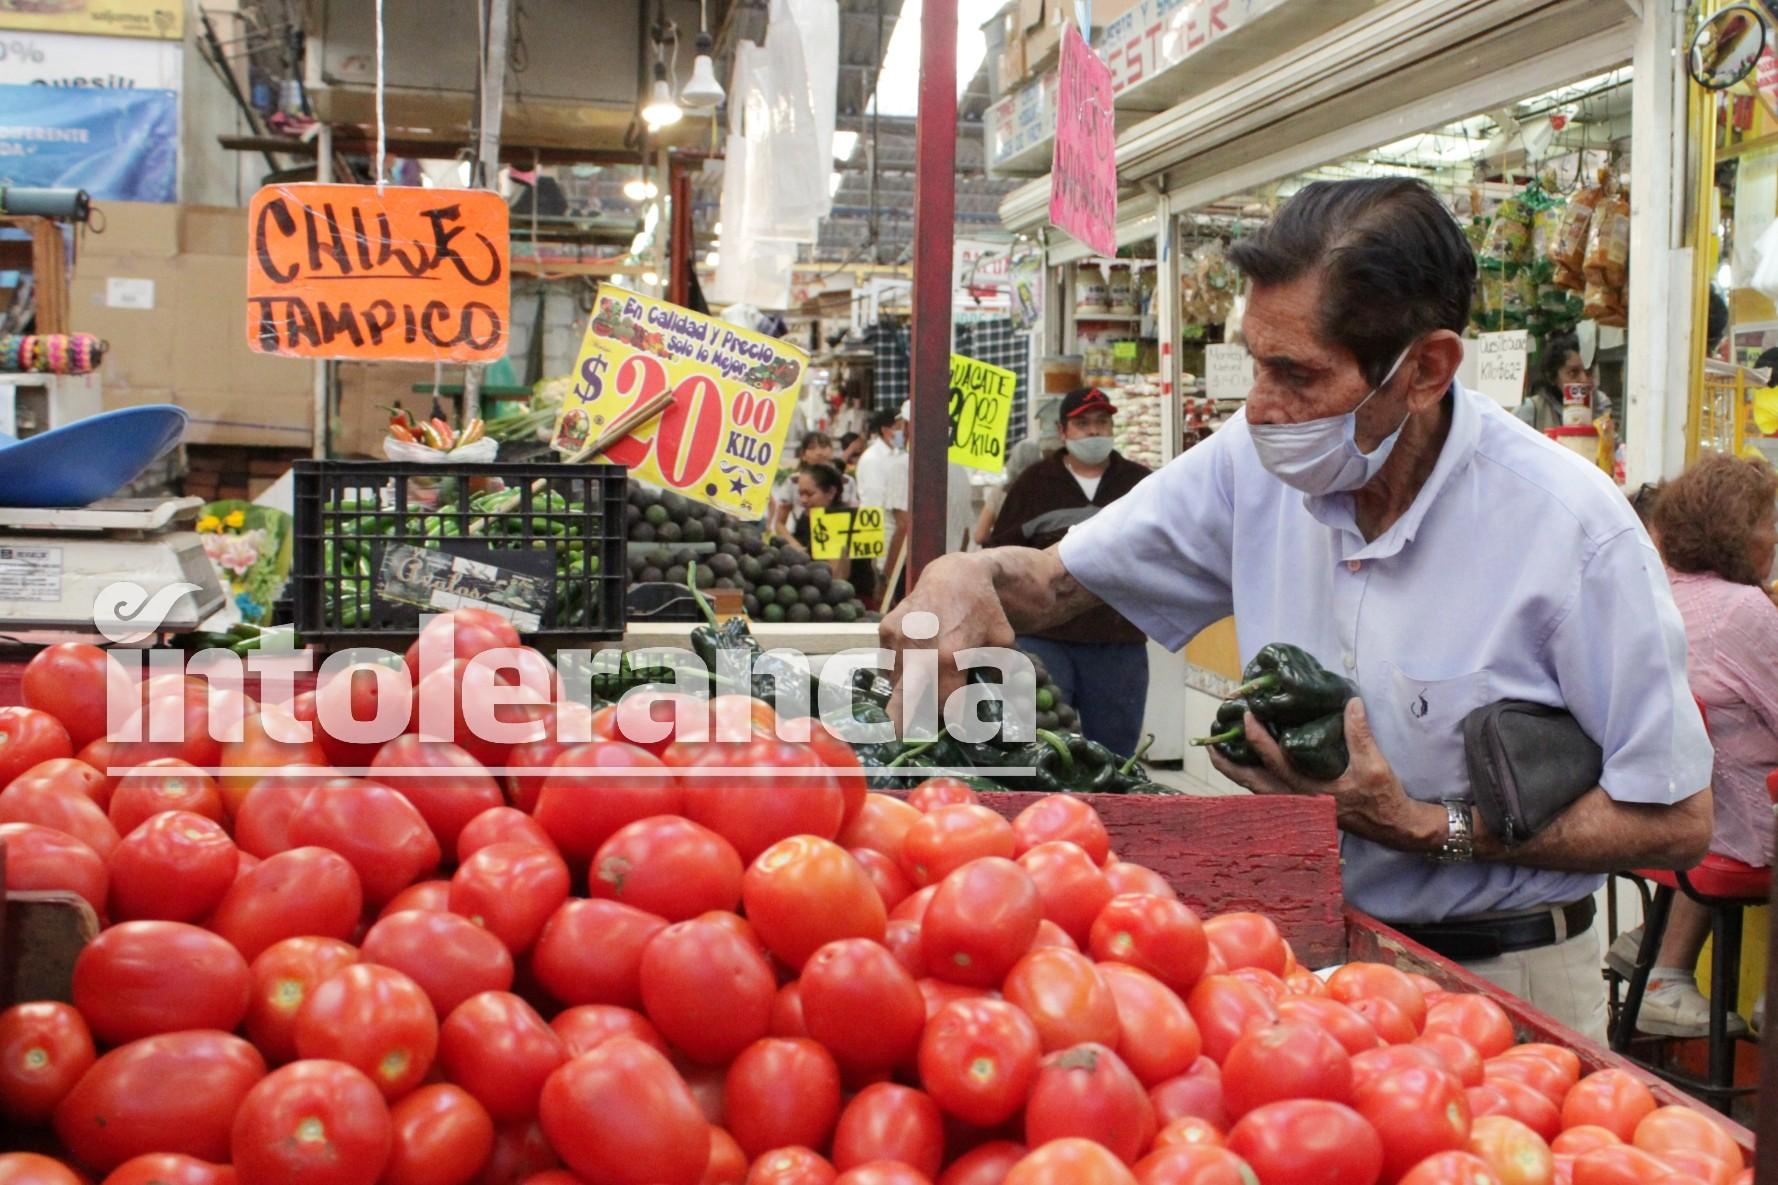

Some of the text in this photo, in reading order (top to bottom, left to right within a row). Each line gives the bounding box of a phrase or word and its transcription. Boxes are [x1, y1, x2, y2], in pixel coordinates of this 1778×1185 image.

[256, 197, 502, 286] CHILE
[247, 296, 502, 351] TAMPICO
[623, 297, 643, 321] En
[648, 306, 708, 343] Calidad
[721, 331, 774, 364] Precio
[695, 345, 709, 362] lo
[711, 351, 748, 378] Mejor
[601, 354, 723, 489] 20
[731, 390, 777, 434] 00
[725, 431, 772, 467] KILO
[970, 432, 1000, 457] KILO
